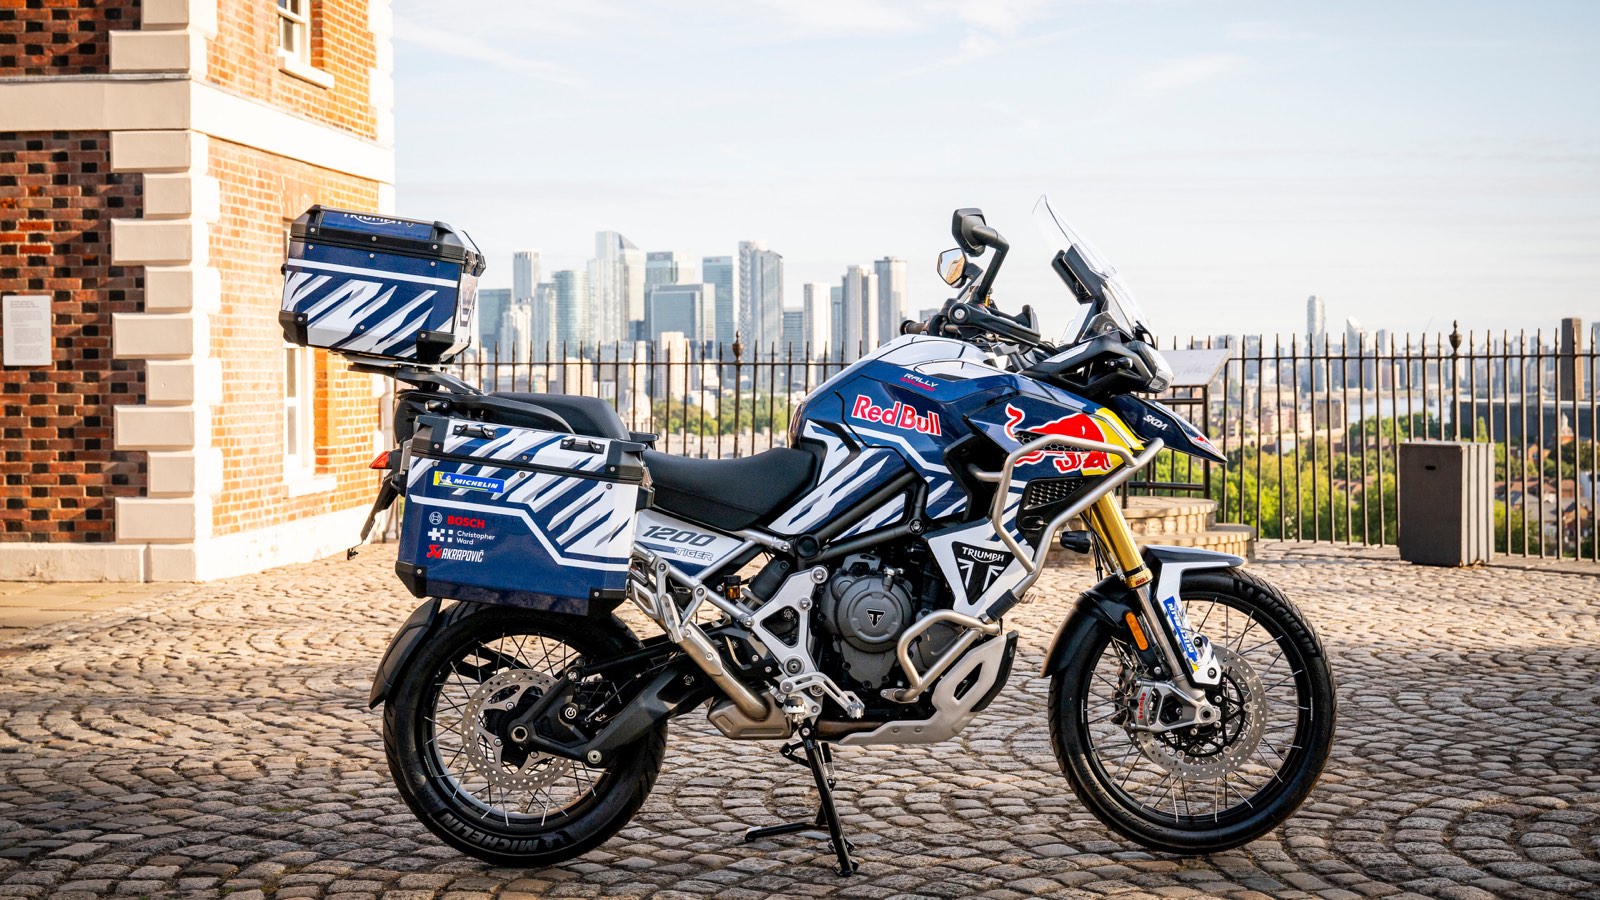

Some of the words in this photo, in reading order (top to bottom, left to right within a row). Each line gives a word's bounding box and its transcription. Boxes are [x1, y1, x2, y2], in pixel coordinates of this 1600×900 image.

[903, 373, 939, 388] RALLY
[852, 395, 901, 426] Red
[898, 404, 942, 436] Bull
[453, 478, 499, 489] MICHELIN
[447, 515, 485, 528] BOSCH
[456, 530, 496, 540] Christopher
[642, 525, 717, 546] 1200
[674, 546, 714, 561] TIGER
[962, 546, 1005, 563] TRIUMPH
[1138, 692, 1147, 719] brembo
[439, 812, 540, 851] MICHELIN
